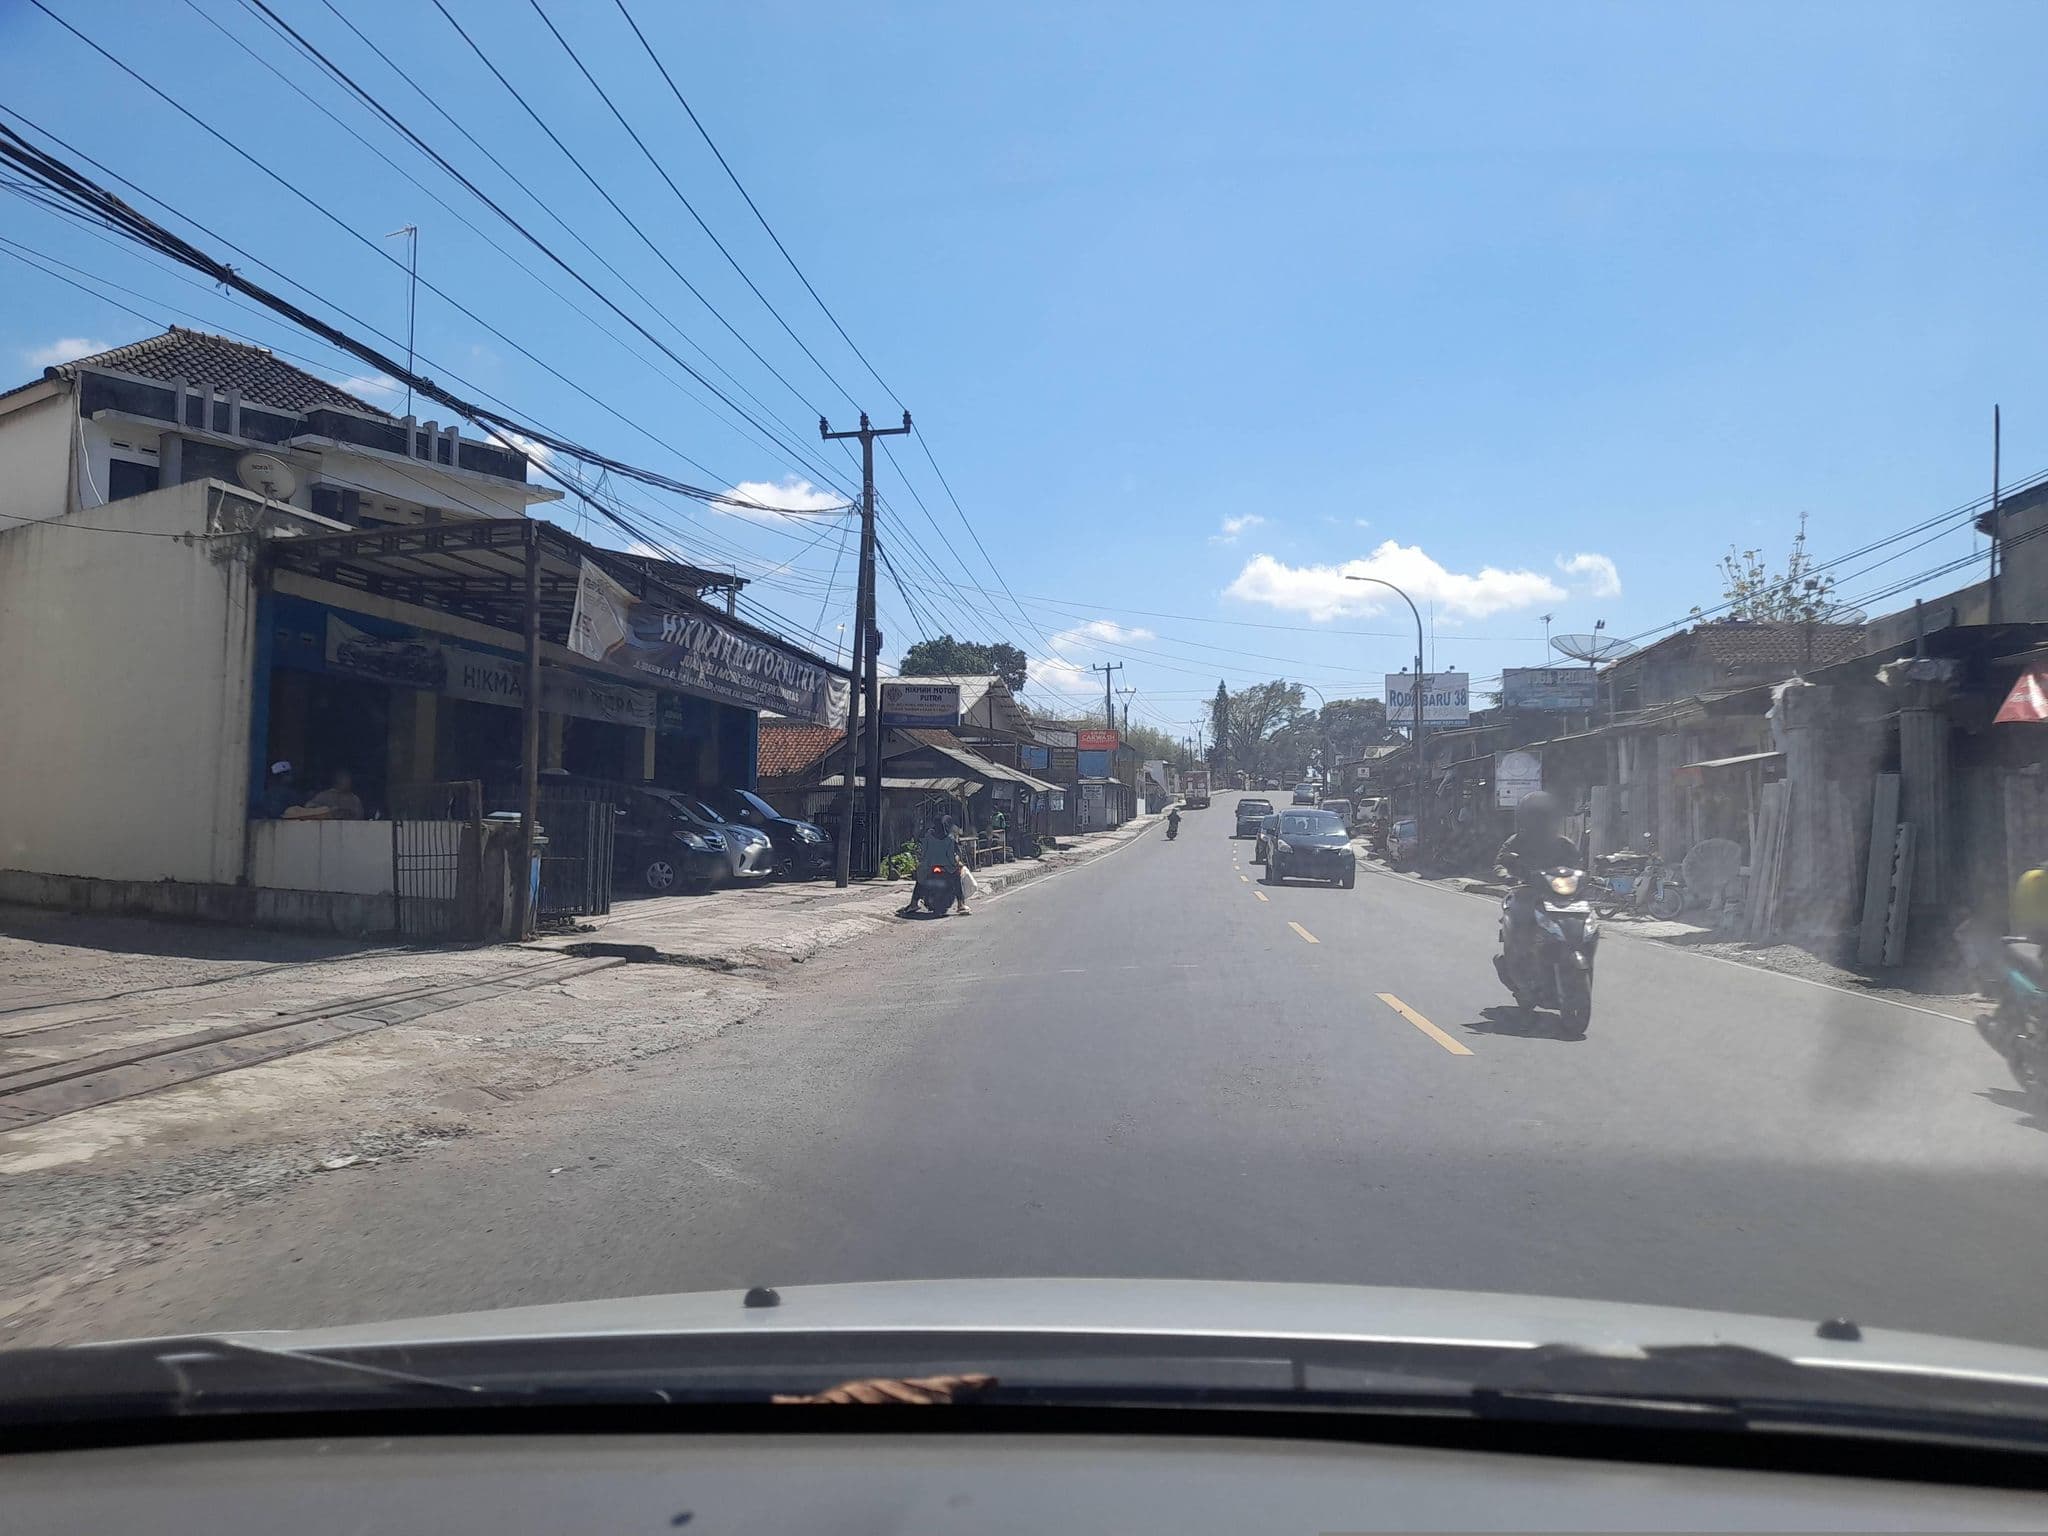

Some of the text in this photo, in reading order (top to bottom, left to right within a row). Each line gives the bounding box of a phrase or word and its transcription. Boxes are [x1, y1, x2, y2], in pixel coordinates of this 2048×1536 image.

[464, 664, 522, 696] HIKMA
[933, 687, 957, 695] MOTOR
[1423, 692, 1450, 707] BARU
[1454, 688, 1467, 706] 38
